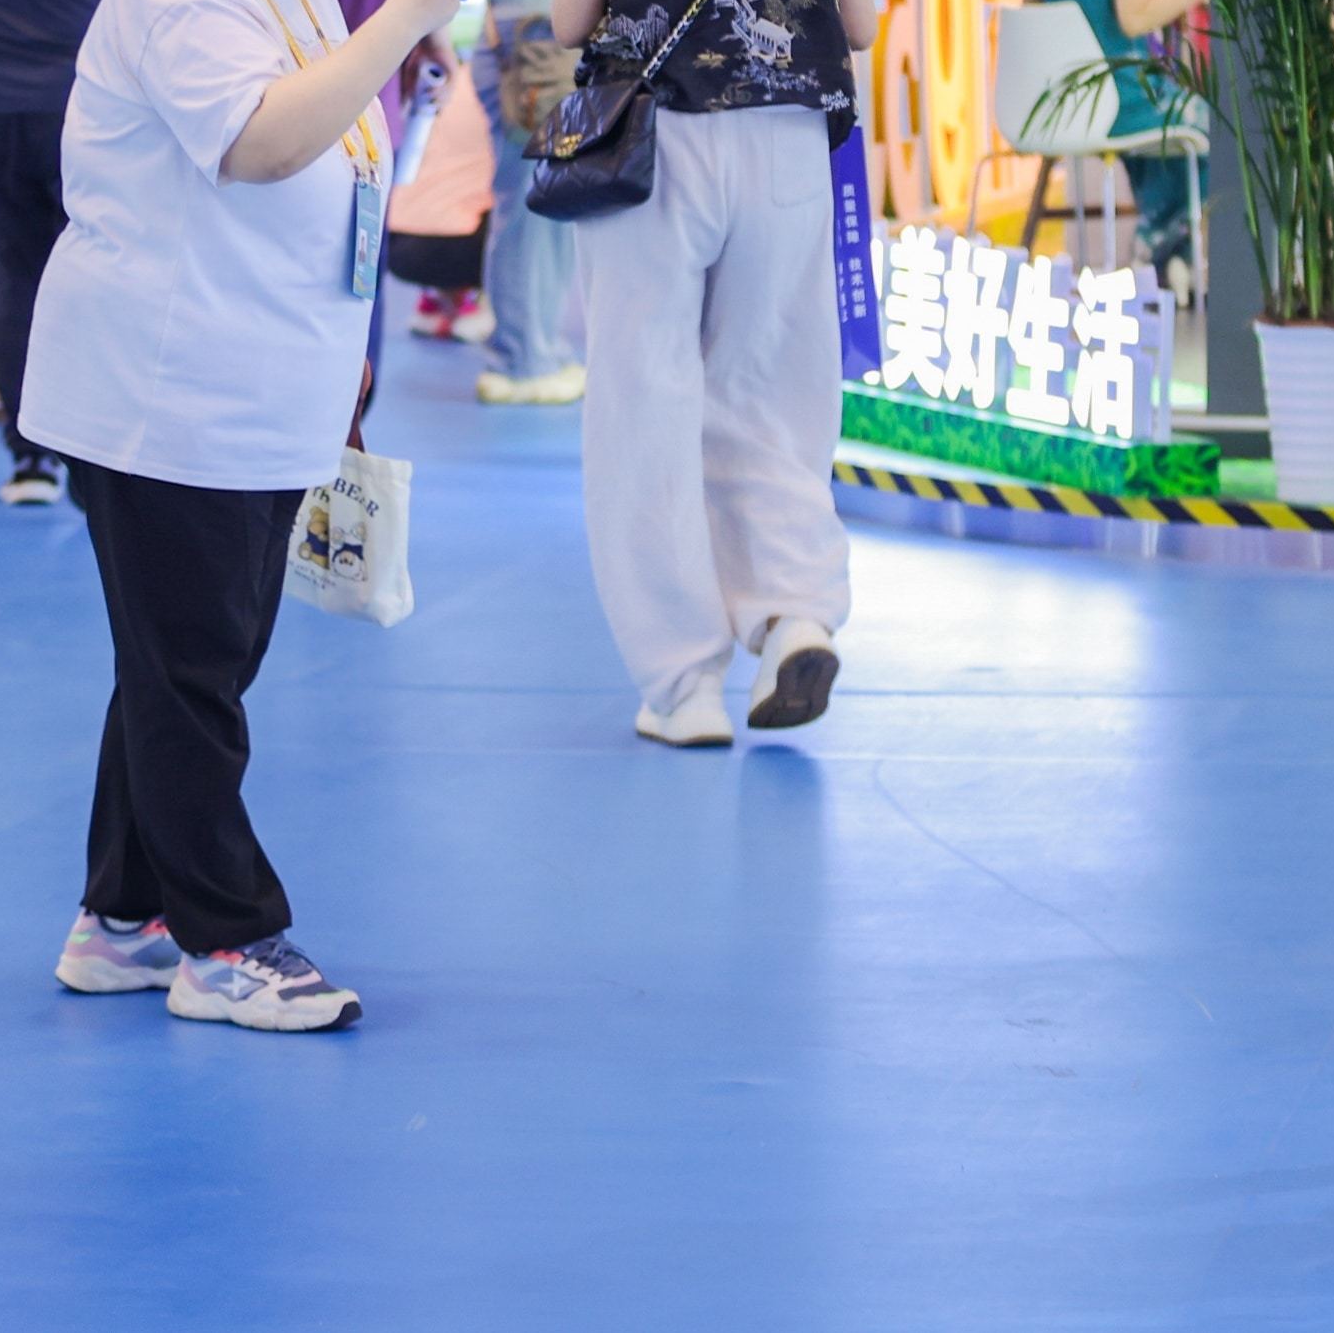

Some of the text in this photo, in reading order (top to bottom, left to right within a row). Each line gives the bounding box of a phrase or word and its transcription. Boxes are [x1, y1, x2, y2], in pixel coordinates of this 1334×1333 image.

[842, 183, 860, 245] 质量保障
[848, 257, 867, 320] 技术创新
[863, 224, 1140, 440] 美好生活
